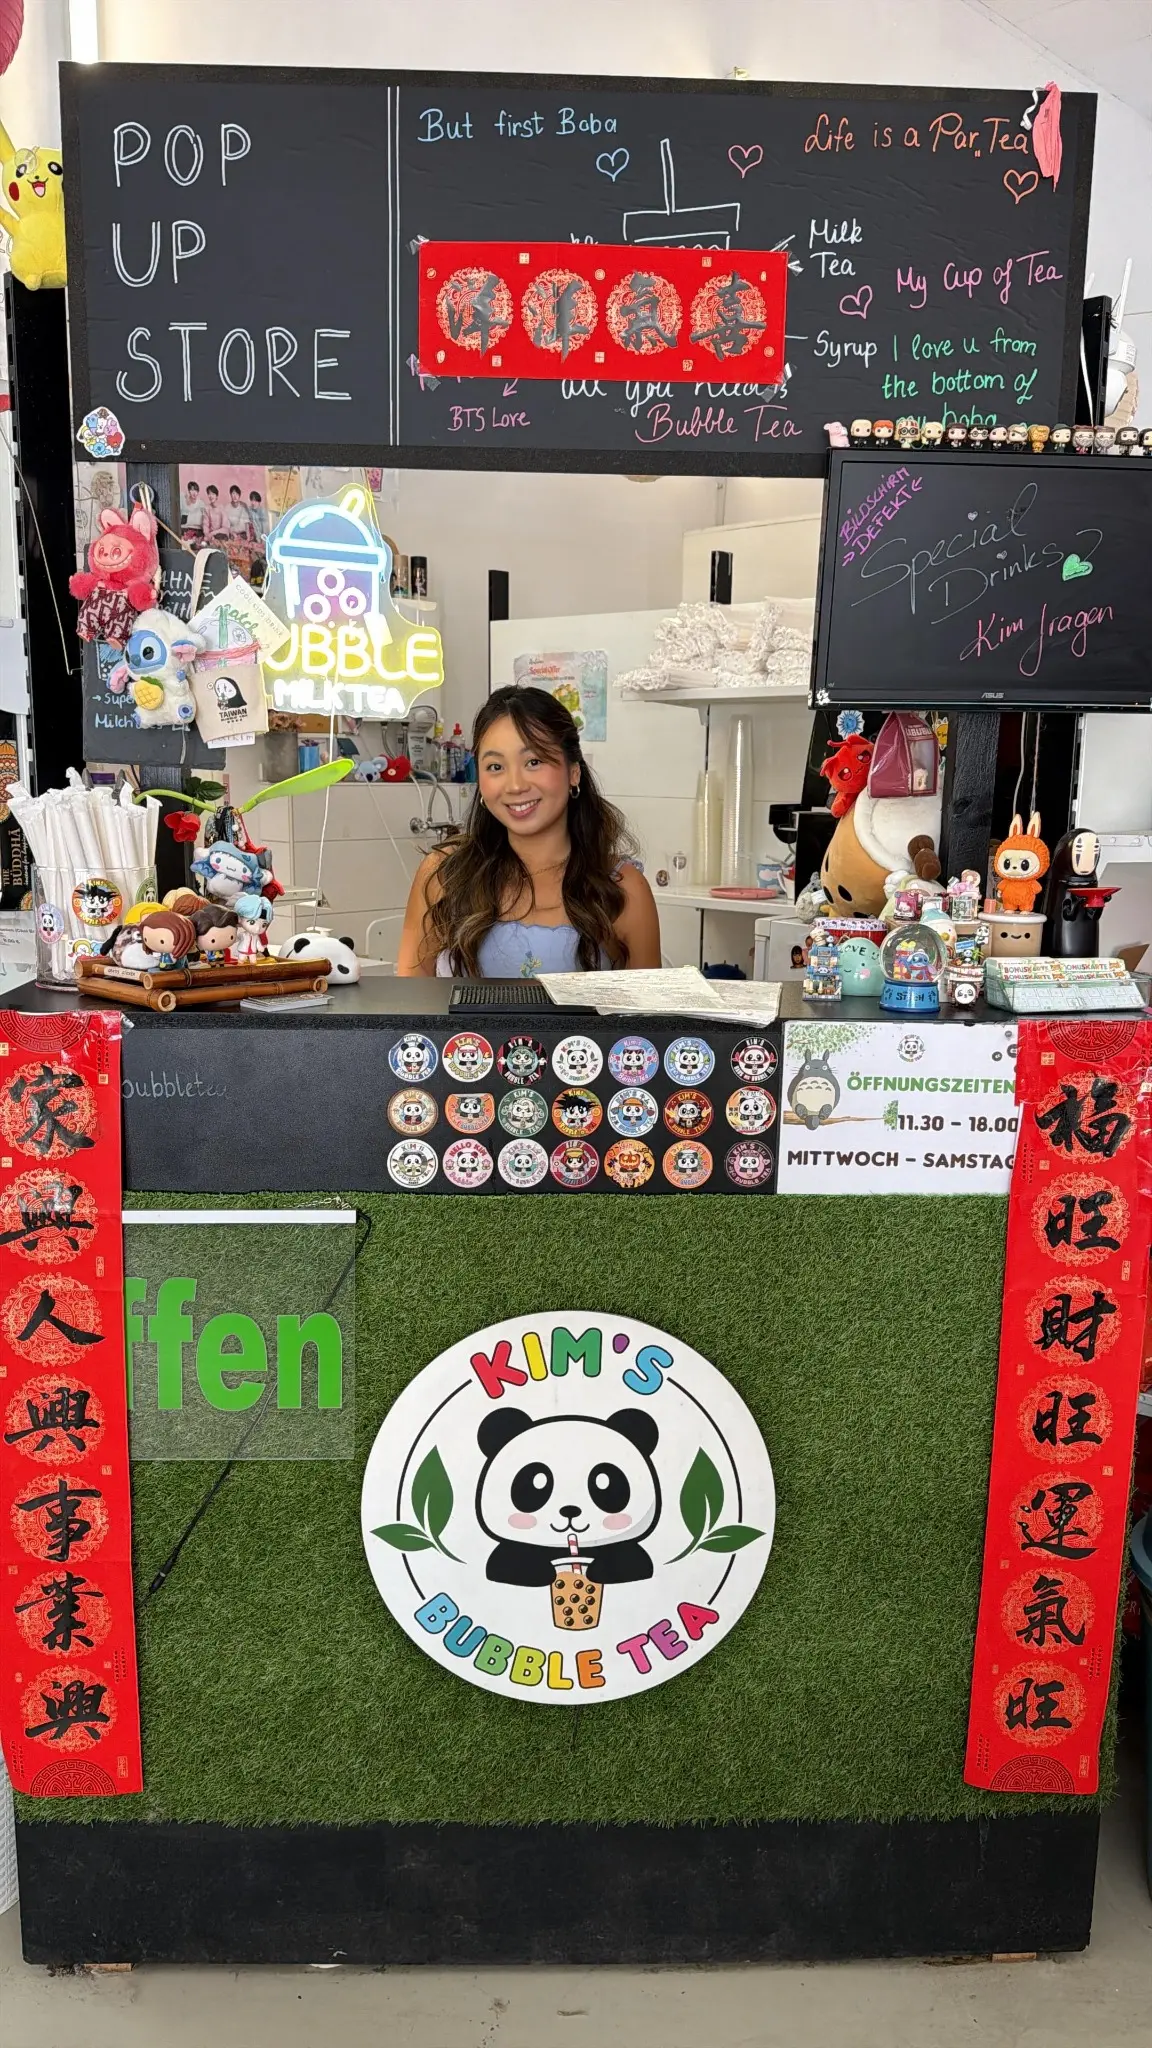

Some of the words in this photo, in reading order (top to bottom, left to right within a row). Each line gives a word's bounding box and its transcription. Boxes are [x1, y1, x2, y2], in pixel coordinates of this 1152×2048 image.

[418, 107, 473, 142] But
[494, 109, 544, 138] first
[556, 107, 617, 135] Boba
[804, 113, 855, 153] Life
[873, 122, 893, 147] is
[903, 127, 920, 147] a
[113, 122, 251, 187] POP
[808, 218, 863, 249] Milk
[112, 220, 206, 287] UP
[810, 251, 856, 278] Tea
[896, 267, 927, 309] My
[943, 262, 982, 298] Cup
[993, 258, 1012, 304] of
[1016, 250, 1064, 285] Tea
[116, 322, 352, 402] STORE
[814, 330, 878, 368] Syrup
[893, 334, 898, 362] I
[912, 334, 954, 361] love
[963, 336, 980, 354] u
[989, 327, 1037, 356] from
[882, 374, 918, 399] the
[932, 370, 1005, 395] bottom
[1013, 369, 1038, 404] of
[447, 406, 485, 432] BTS
[492, 406, 531, 428] Love
[635, 403, 738, 443] Bubble
[744, 404, 803, 442] Tea
[852, 484, 914, 555] DEFEKT
[851, 483, 1038, 614] Special
[264, 622, 440, 681] UBBLE
[960, 612, 1023, 661] Kim
[104, 693, 135, 708] Supe
[219, 708, 248, 718] TAIWAN
[847, 1071, 1016, 1094] ÖFFNUNGSZEITEN
[898, 1115, 944, 1131] 11.30
[969, 1116, 1019, 1133] 18.00
[449, 1142, 472, 1157] HELLO
[474, 1143, 487, 1156] KIM
[788, 1150, 899, 1167] MITTWOCH
[125, 1277, 343, 1410] ffen
[470, 1326, 674, 1399] KIM'S
[414, 1592, 606, 1690] BUBBLE
[616, 1601, 720, 1675] TEA
